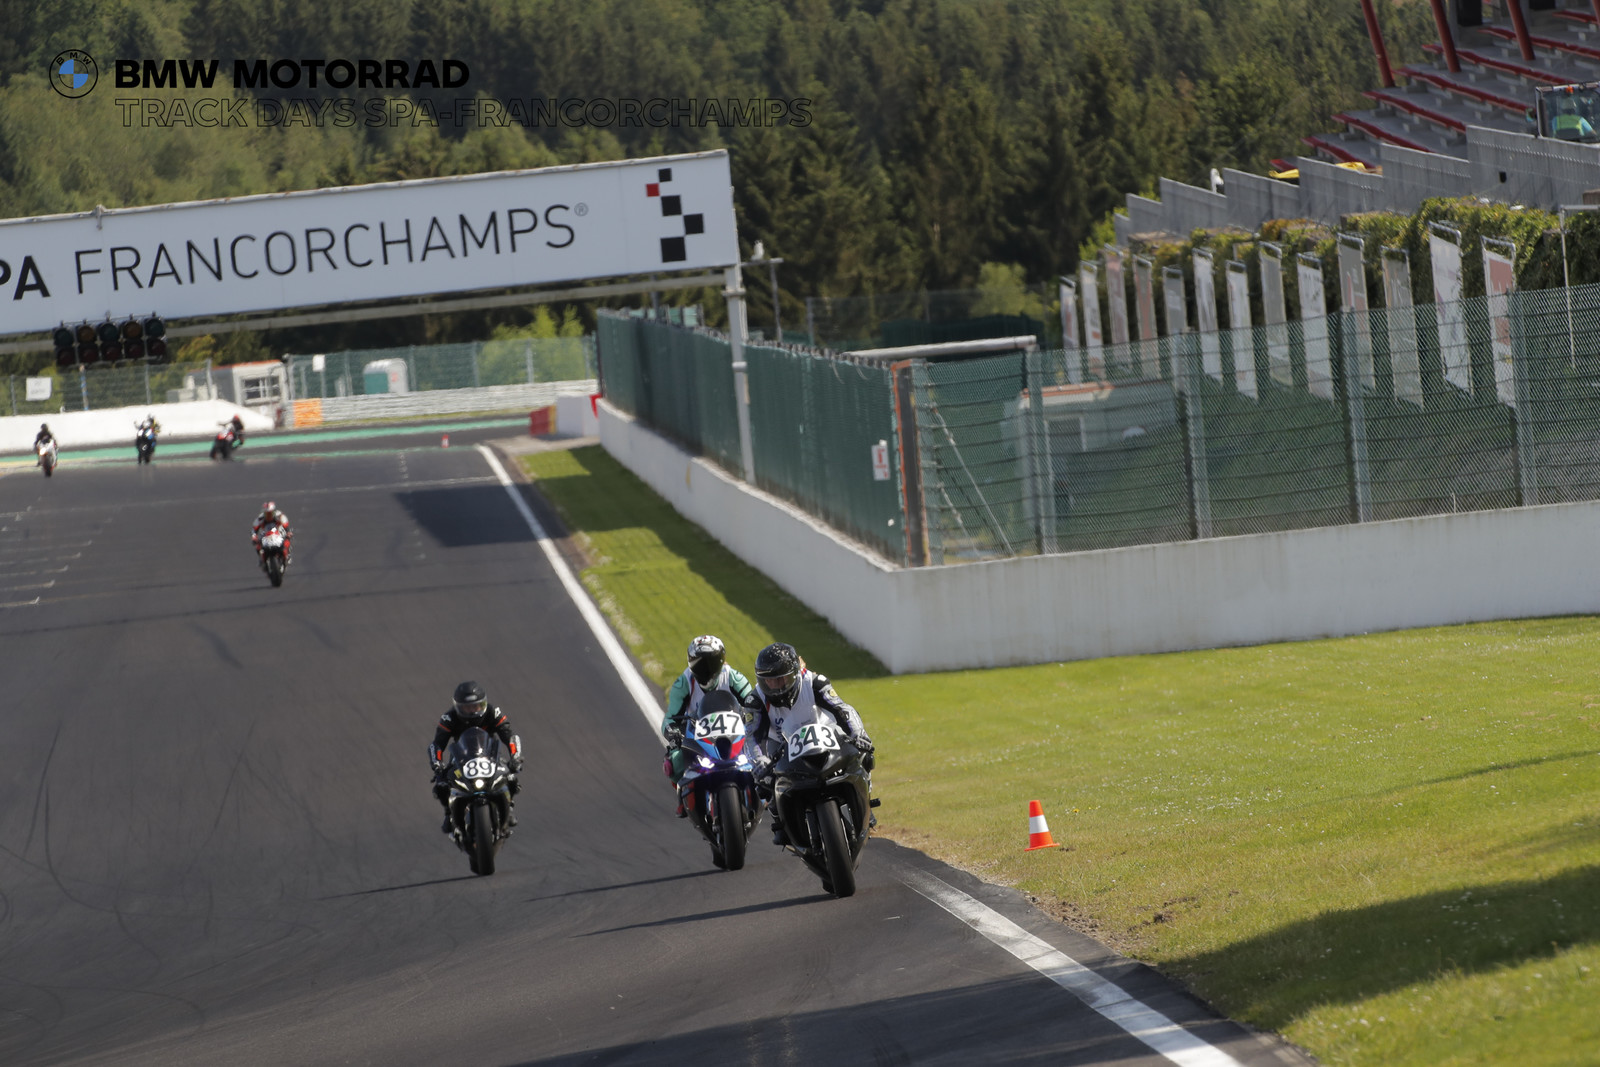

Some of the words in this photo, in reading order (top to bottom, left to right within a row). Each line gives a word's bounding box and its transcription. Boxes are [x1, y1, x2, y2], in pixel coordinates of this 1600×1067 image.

[74, 204, 575, 294] FRANCORCHAMPS
[697, 714, 740, 737] 347
[790, 725, 836, 757] 343
[466, 760, 493, 777] 89
